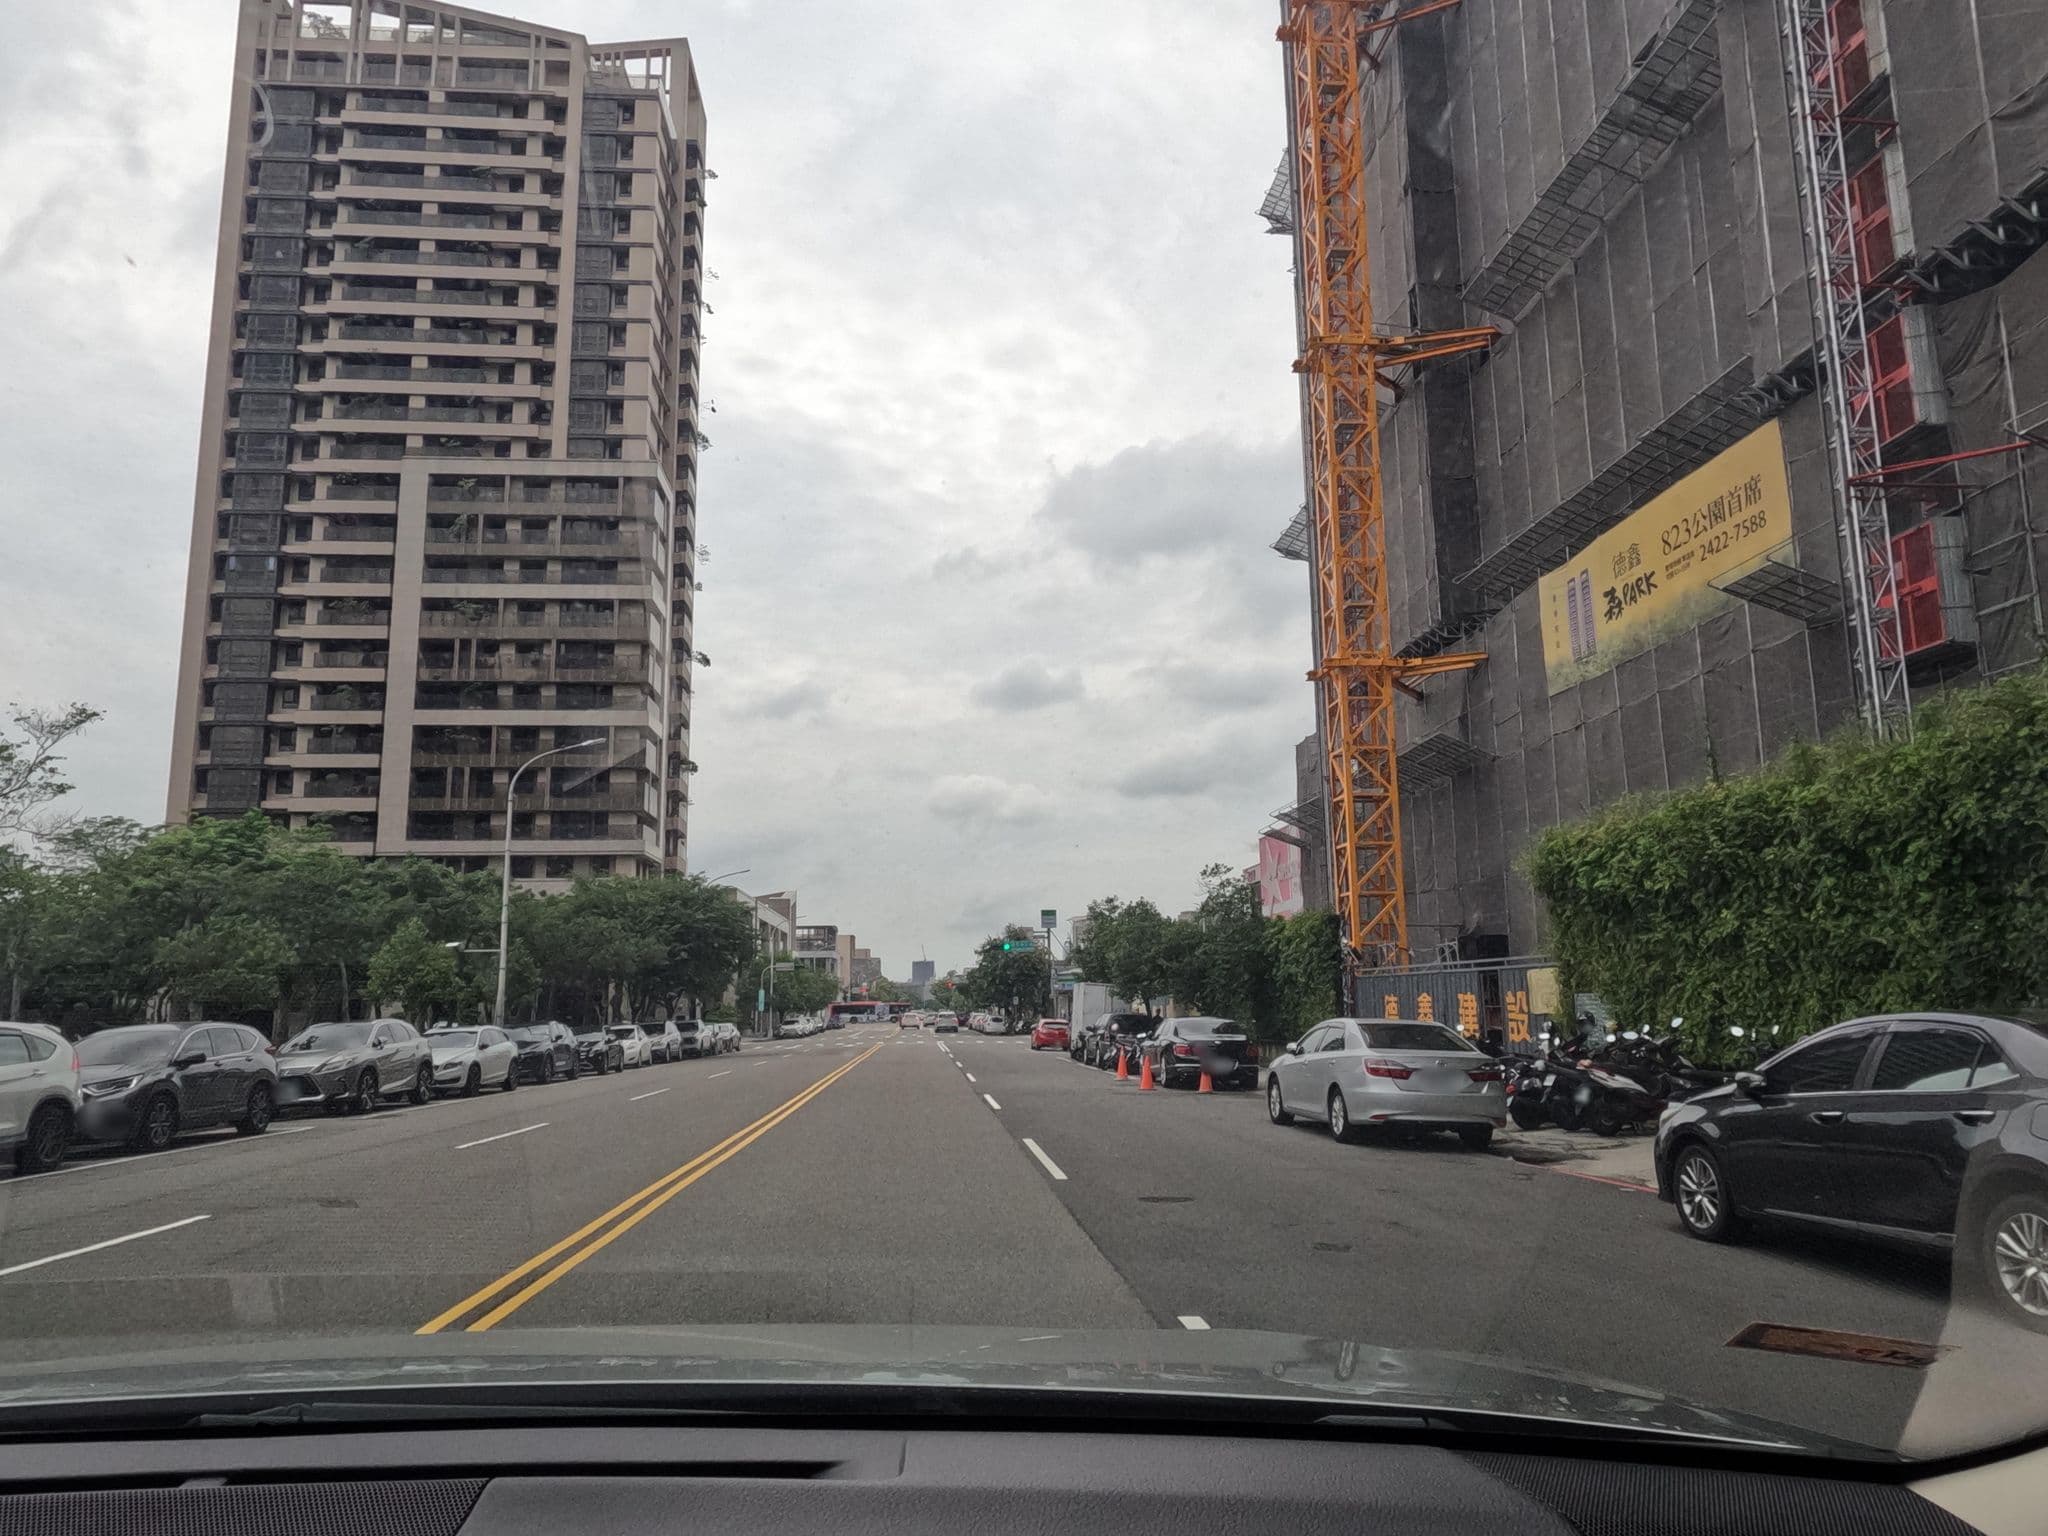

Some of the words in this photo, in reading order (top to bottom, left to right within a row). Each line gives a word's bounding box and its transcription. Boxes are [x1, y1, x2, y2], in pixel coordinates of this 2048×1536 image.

[1661, 473, 1762, 556] 823公園首席
[1699, 509, 1767, 562] 2422-7588
[1611, 542, 1642, 579] 德鑫
